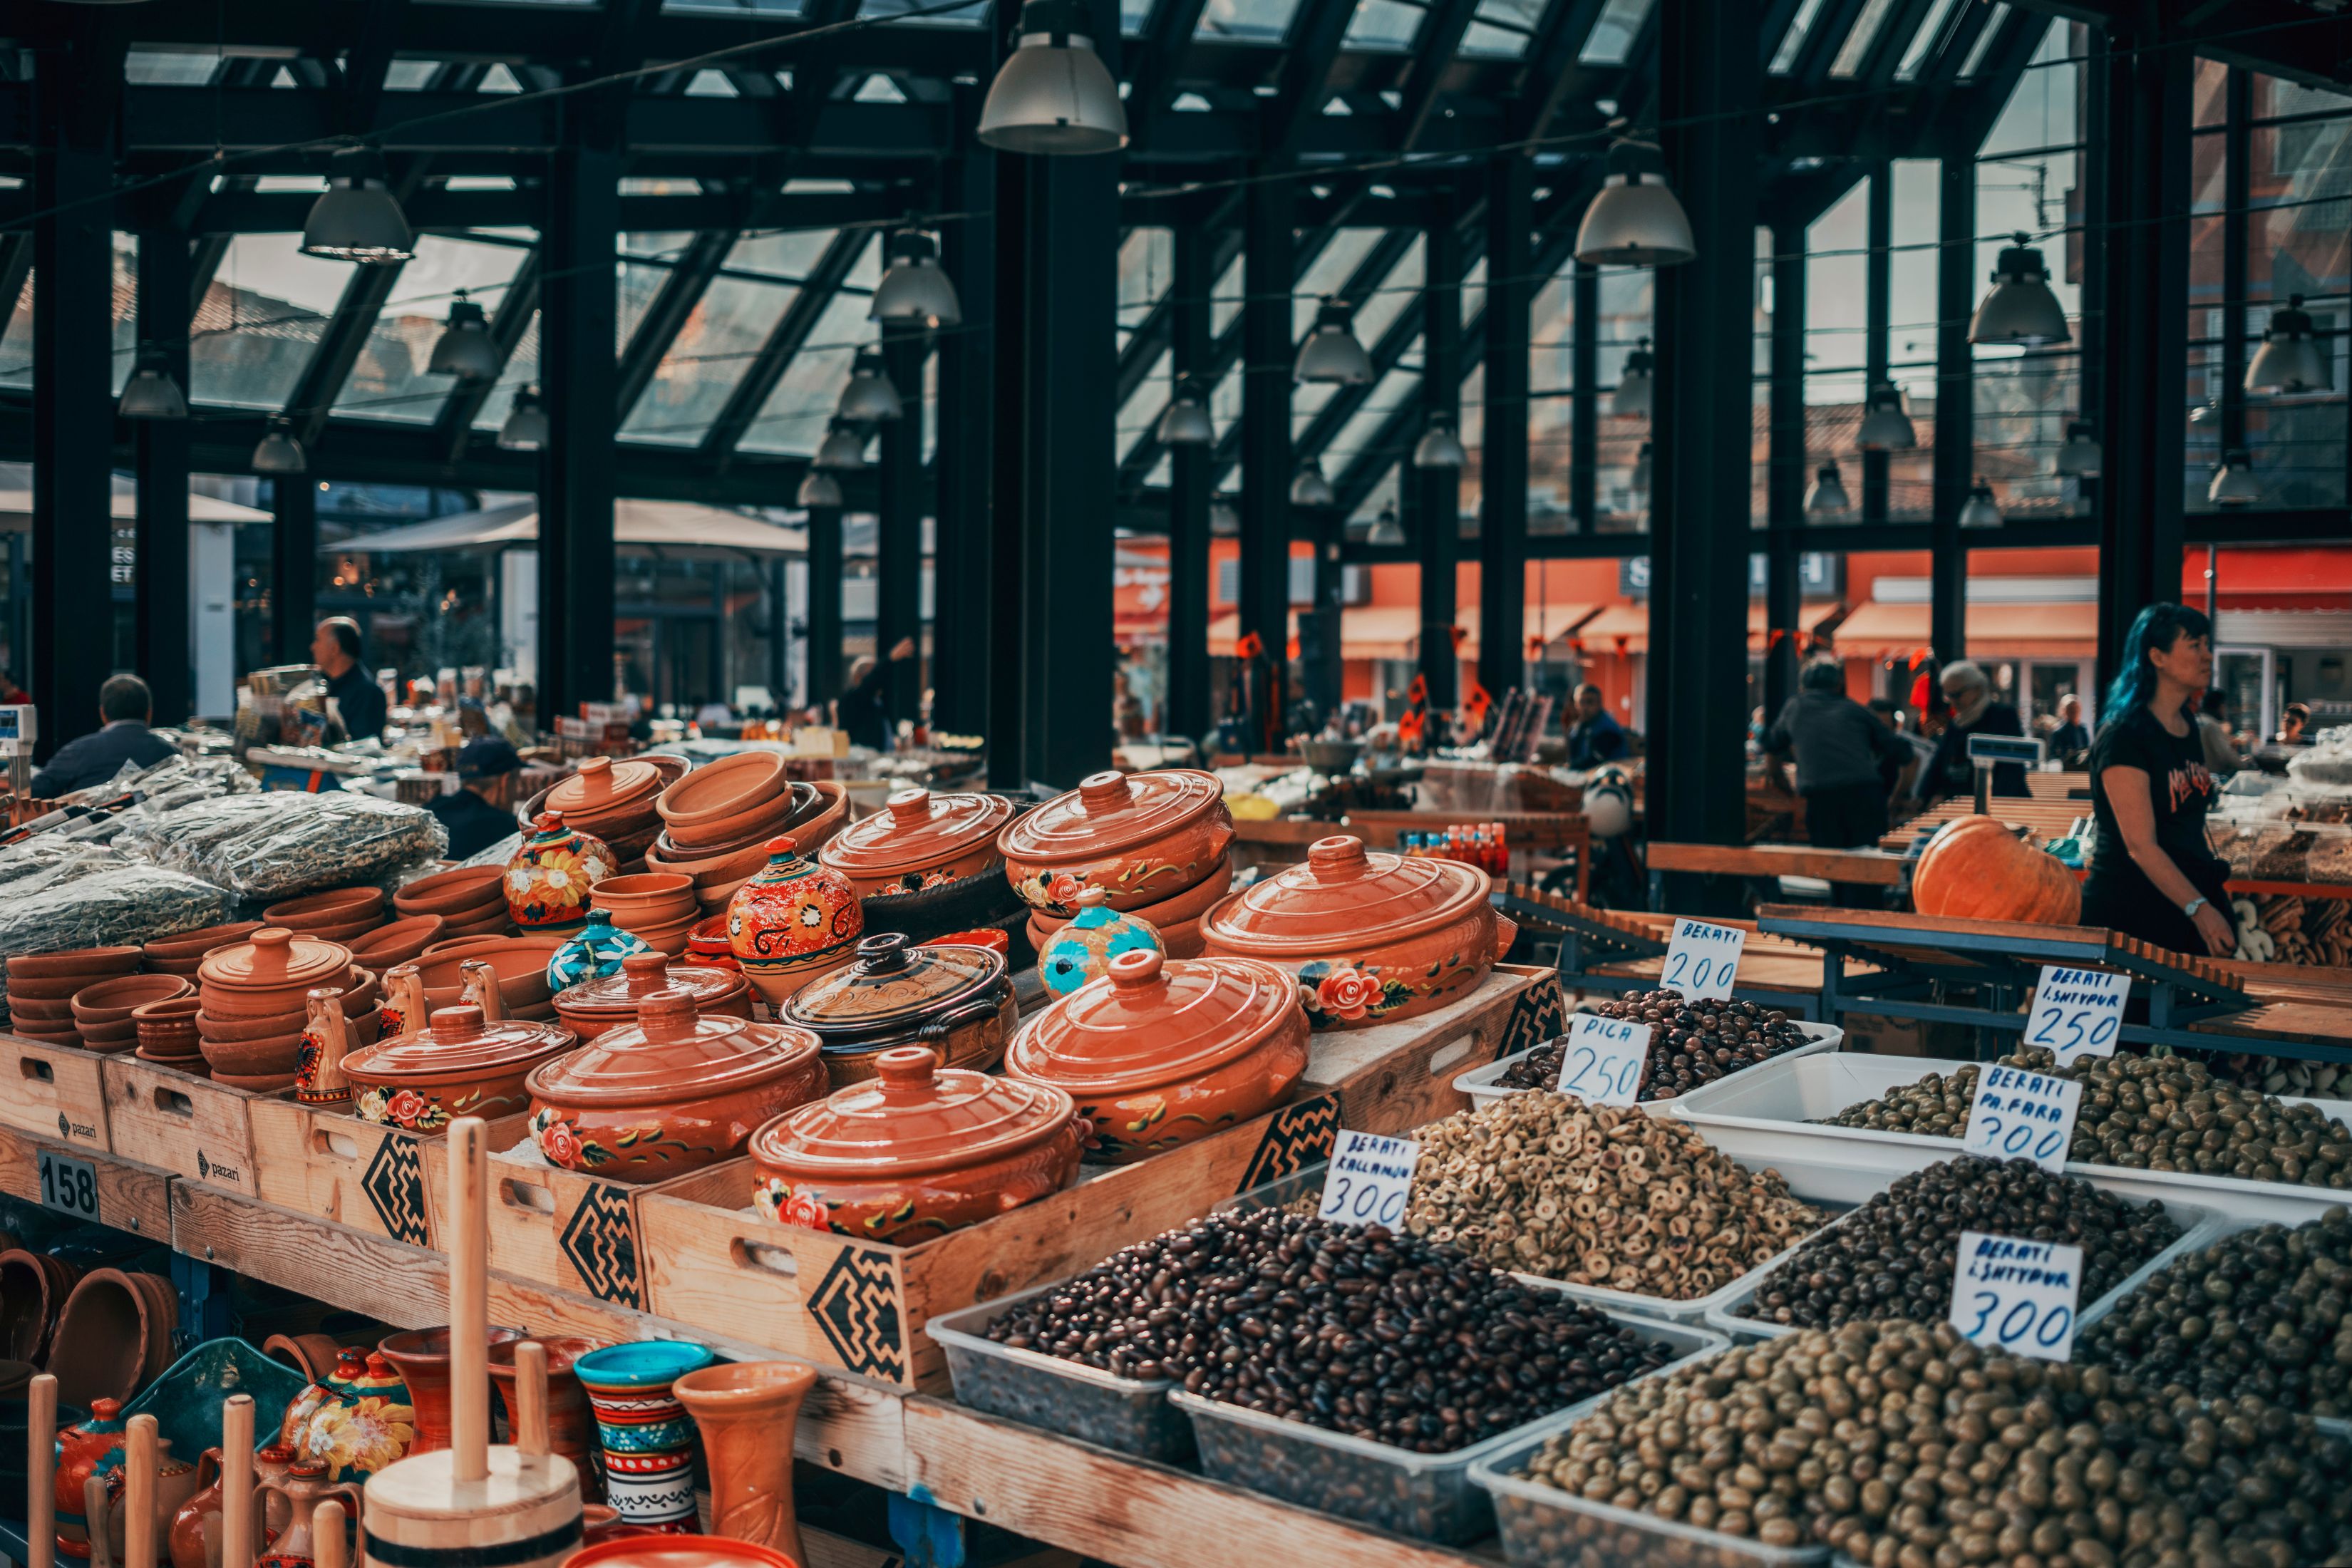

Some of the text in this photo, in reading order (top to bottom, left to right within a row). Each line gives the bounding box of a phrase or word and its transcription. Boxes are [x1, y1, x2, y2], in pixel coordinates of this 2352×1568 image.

[1666, 952, 1734, 989] 200
[2033, 1007, 2118, 1051] 250
[1564, 1047, 1639, 1098] 250
[72, 1123, 97, 1138] pazari
[1971, 1116, 2064, 1159] 300
[41, 1156, 96, 1214] 158
[211, 1163, 240, 1182] pazari
[1324, 1177, 1404, 1223] 300
[1965, 1291, 2071, 1347] 300
